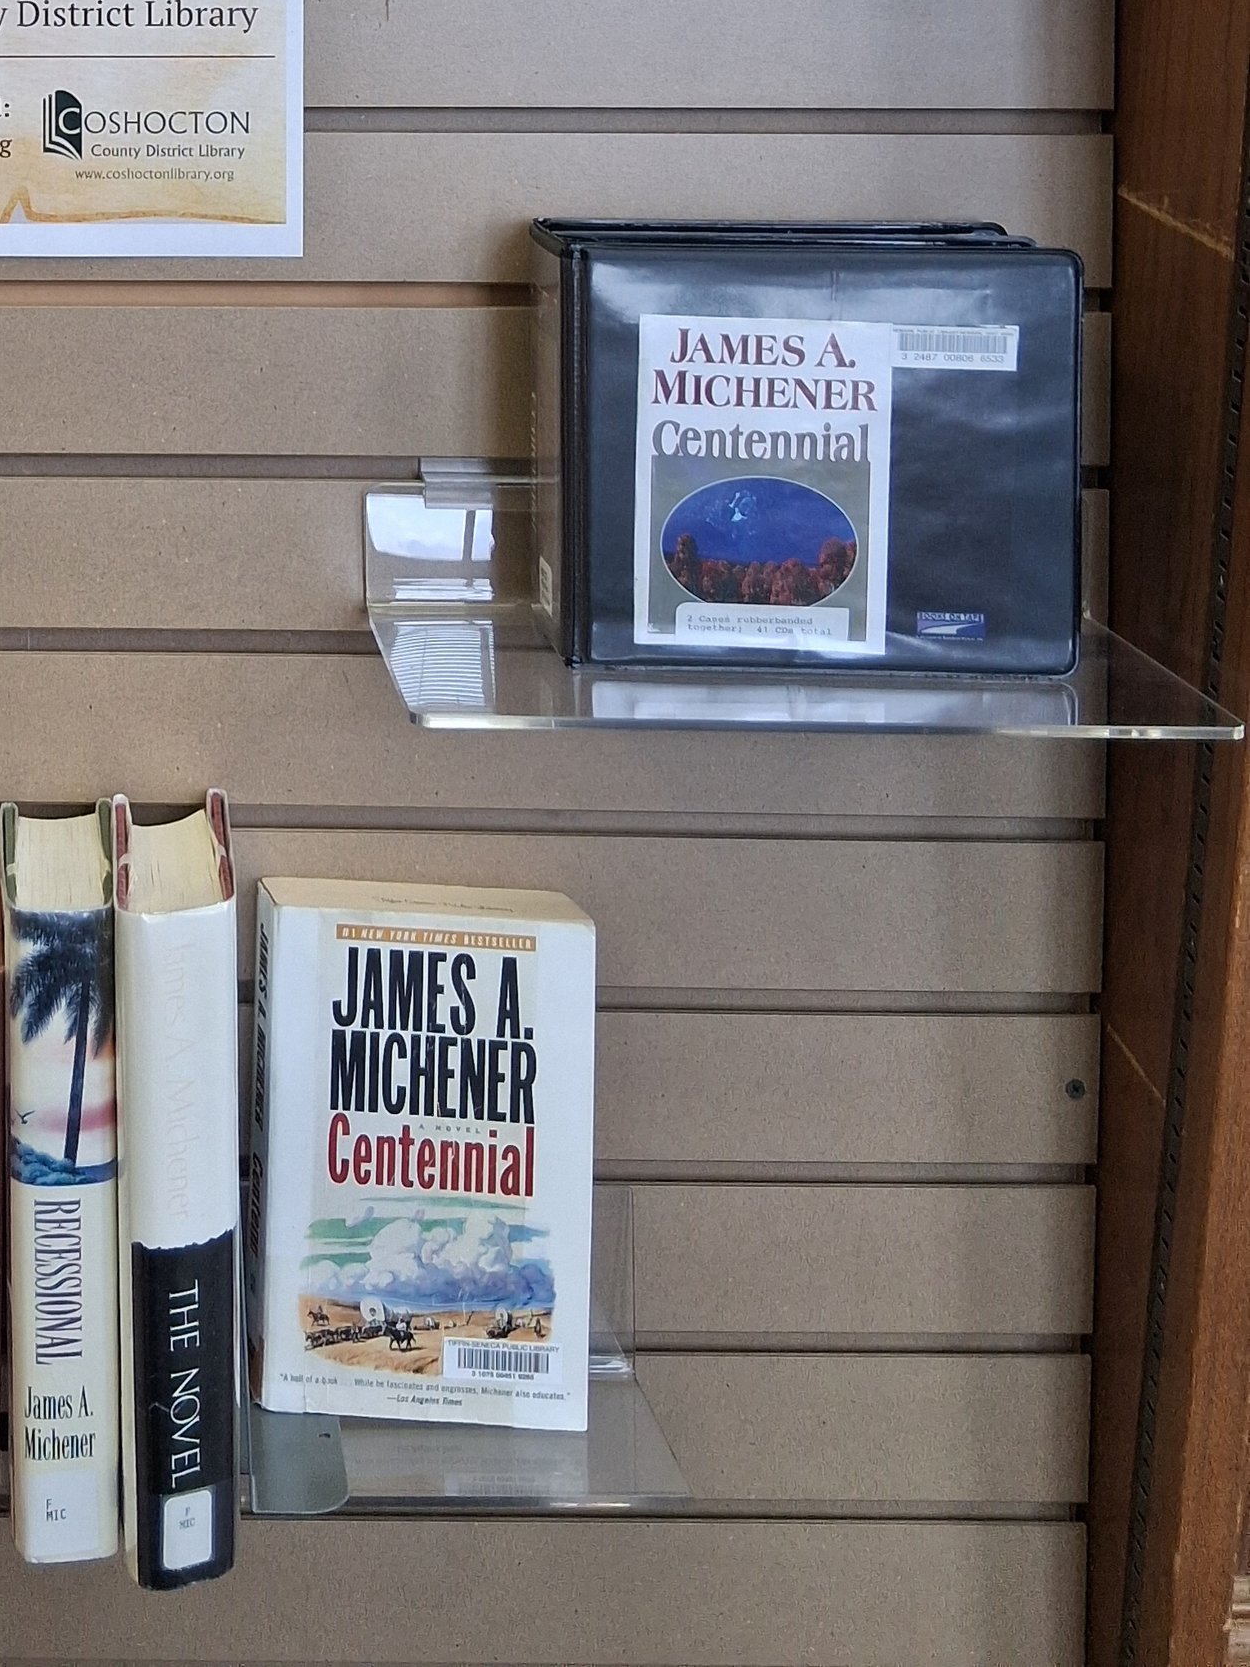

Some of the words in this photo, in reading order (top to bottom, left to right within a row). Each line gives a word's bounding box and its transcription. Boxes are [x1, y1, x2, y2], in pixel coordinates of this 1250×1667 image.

[16, 0, 135, 28] District
[58, 108, 250, 135] COSHOCTON
[90, 143, 142, 160] County
[146, 143, 194, 158] District
[198, 143, 246, 160] Library
[74, 167, 235, 183] www.coshoctonlibrary.org
[670, 327, 807, 367] JAMES
[814, 332, 857, 370] A.
[651, 368, 879, 412] MICHENER
[651, 419, 871, 463] Centennial
[361, 927, 384, 940] NEW
[390, 929, 417, 942] YORK
[423, 932, 457, 945] TIMES
[464, 936, 533, 949] BESTSELLER
[332, 946, 477, 1036] JAMES
[497, 956, 534, 1040] A.
[330, 1029, 537, 1124] MICHENER
[328, 1112, 535, 1197] Centennial
[33, 1199, 84, 1366] RECESSIONAL
[168, 1279, 201, 1352] THE
[24, 1385, 73, 1420] James
[77, 1385, 94, 1417] A.
[24, 1426, 96, 1462] Michener
[169, 1367, 201, 1489] NOVEL
